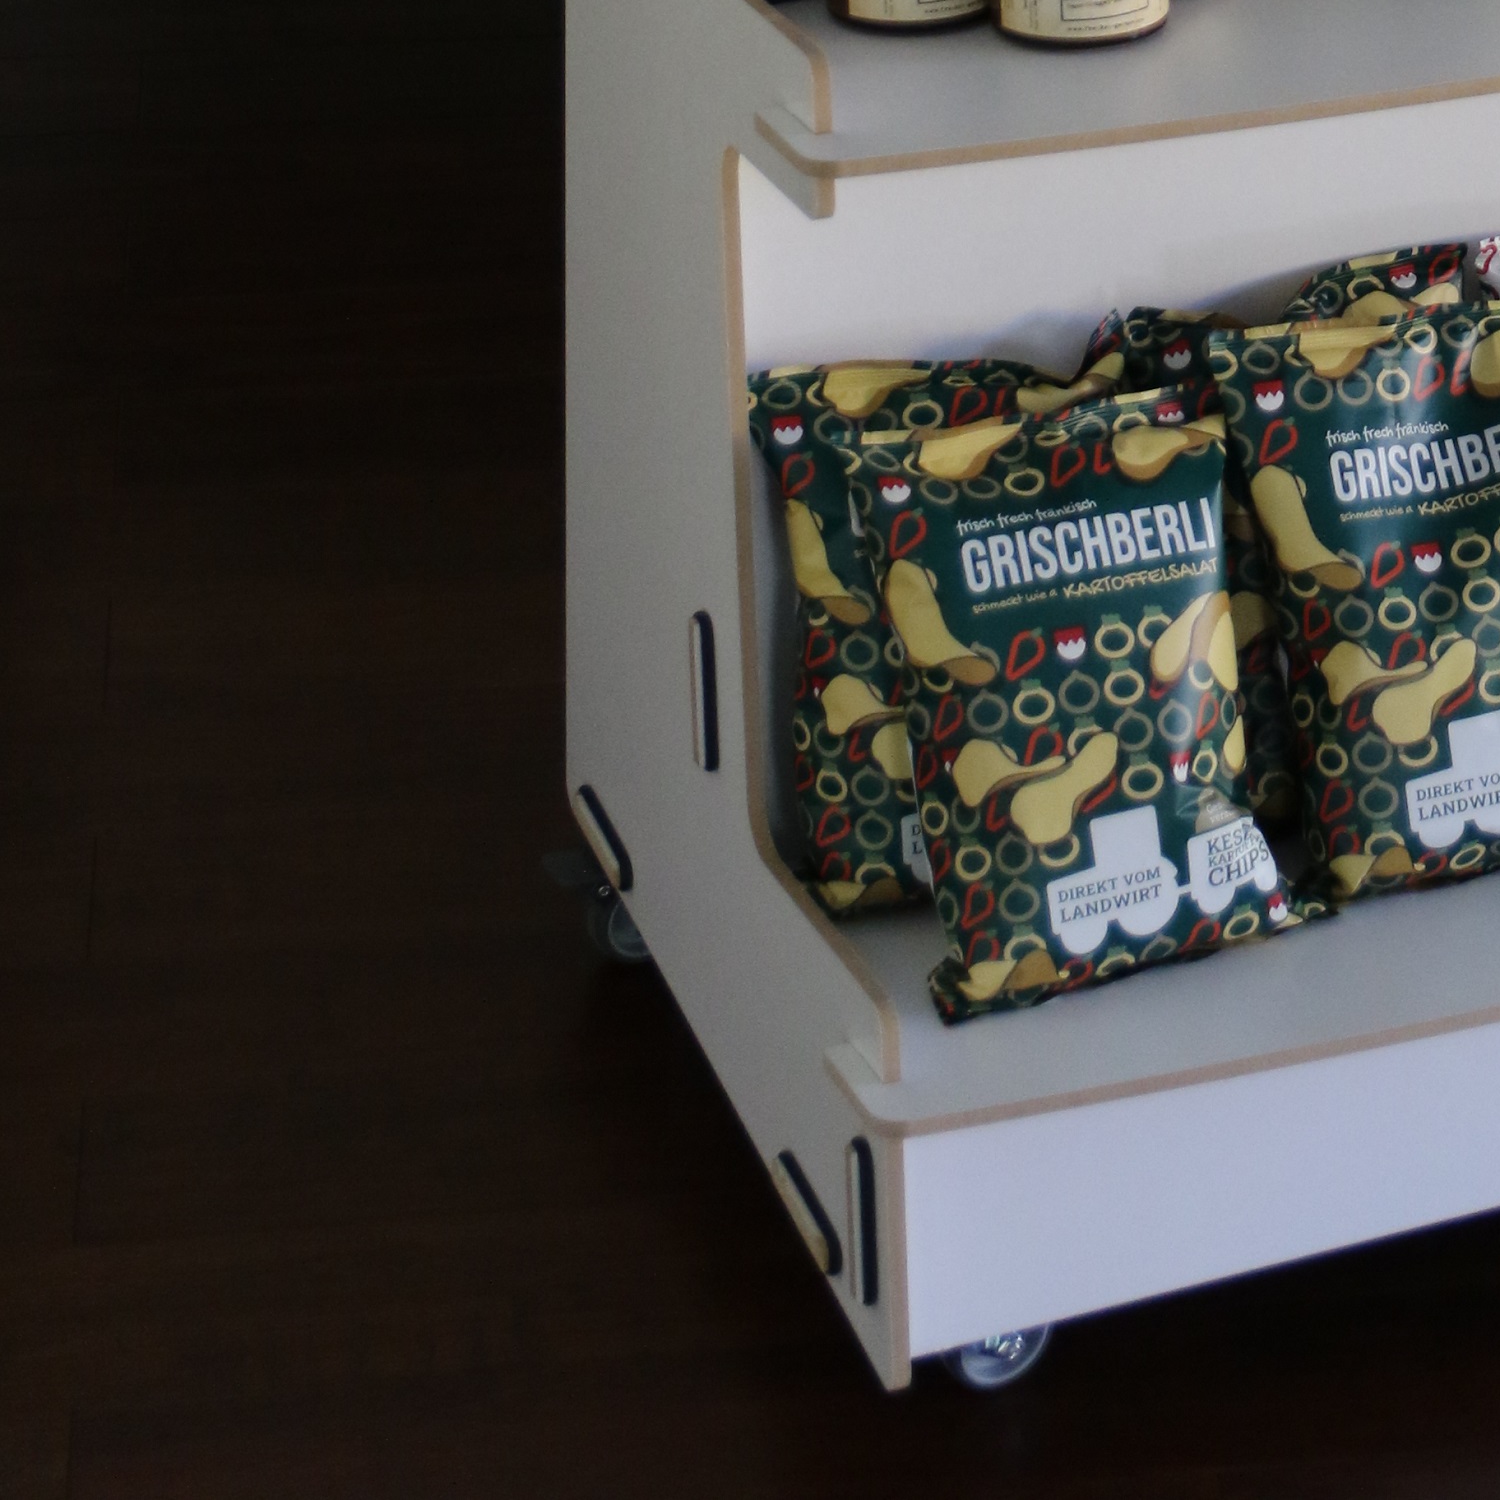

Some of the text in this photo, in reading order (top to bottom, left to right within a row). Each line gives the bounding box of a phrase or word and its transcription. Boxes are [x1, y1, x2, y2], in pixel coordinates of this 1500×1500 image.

[1325, 420, 1449, 448] frisch frech fränkisch
[956, 498, 1098, 537] frisch frech fränkisch
[1339, 506, 1384, 523] schmeckt
[1385, 505, 1405, 518] wie
[960, 496, 1217, 594] GRISCHBERLI
[972, 556, 1218, 615] schmeckt wie a KARTOFFELSALAT
[1416, 777, 1474, 802] DIREKT
[1208, 839, 1270, 888] CHIPS
[1058, 866, 1161, 903] DIREKT VOM
[1060, 883, 1163, 924] LANDWIRT
